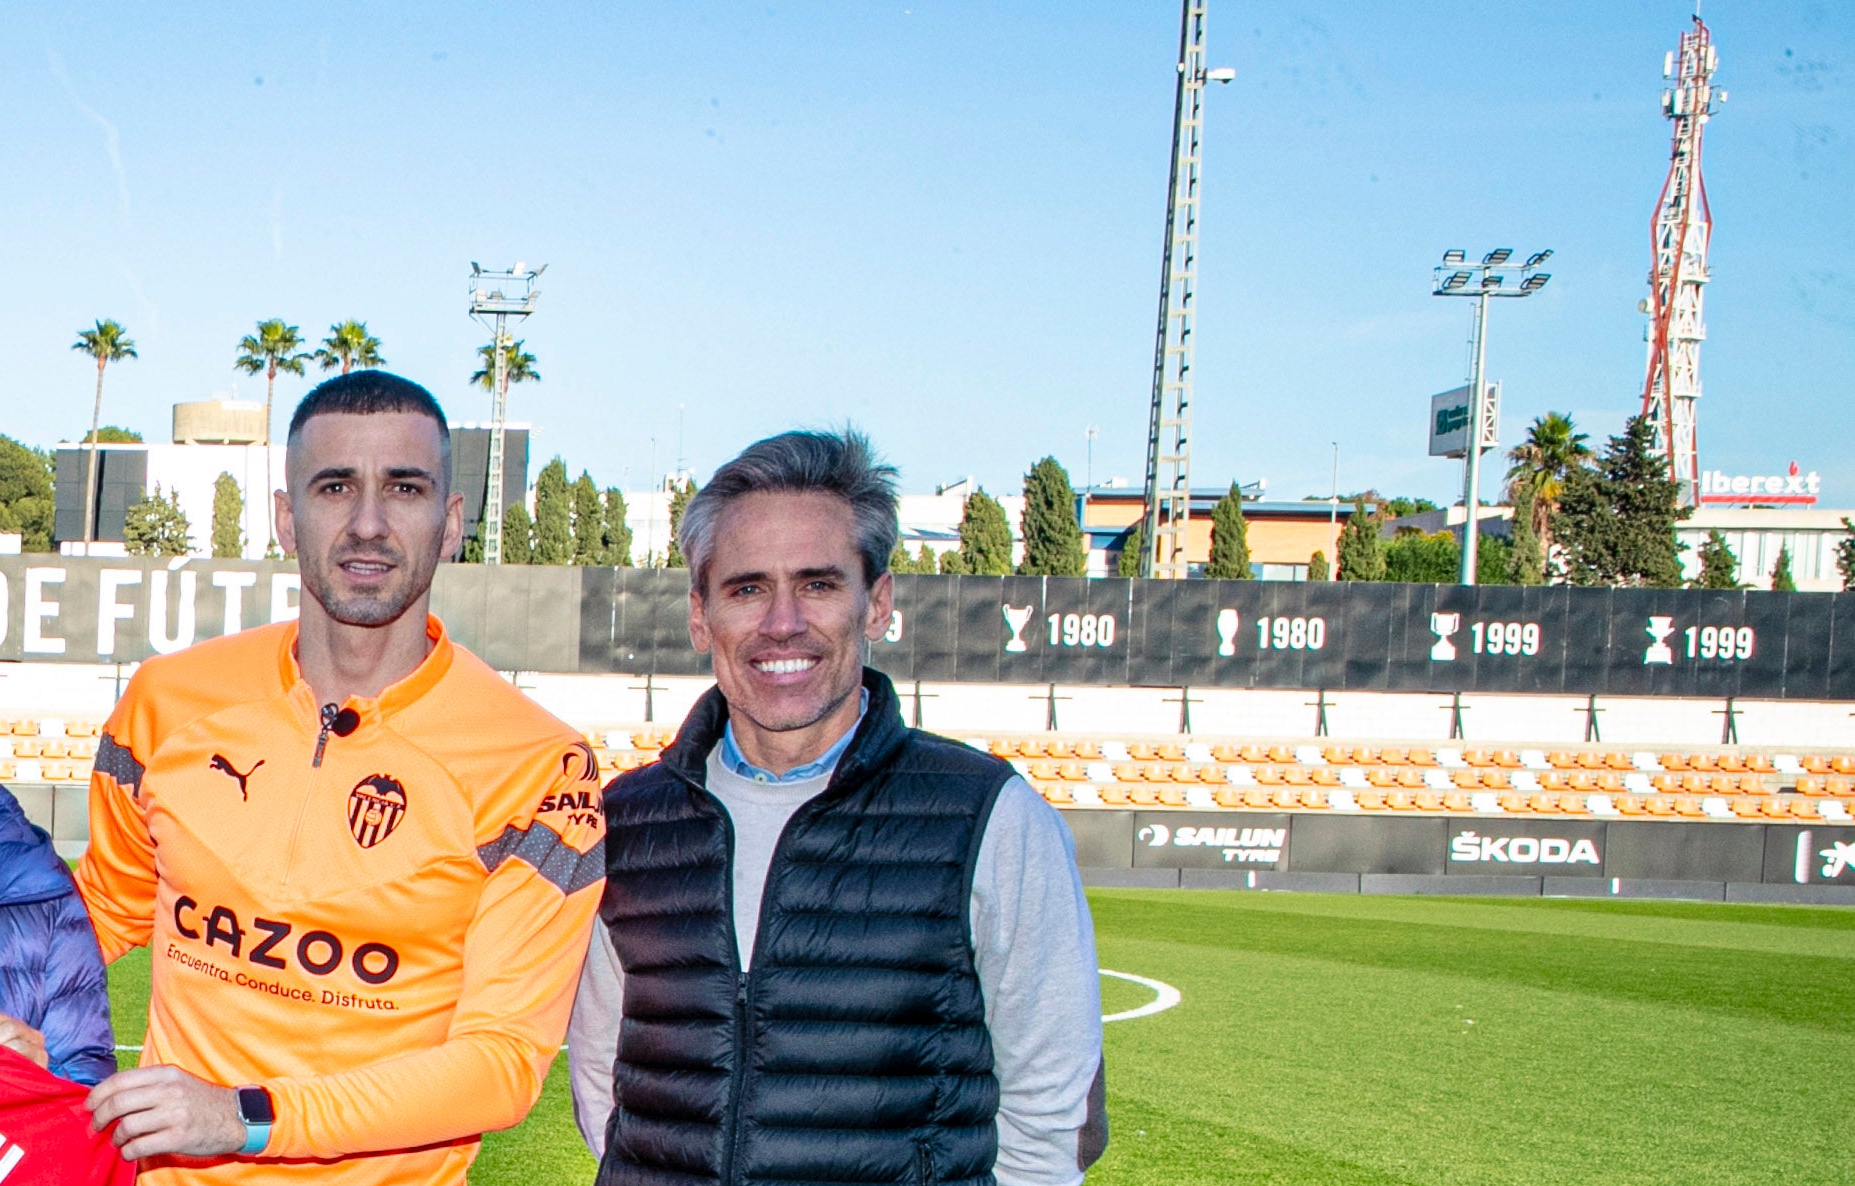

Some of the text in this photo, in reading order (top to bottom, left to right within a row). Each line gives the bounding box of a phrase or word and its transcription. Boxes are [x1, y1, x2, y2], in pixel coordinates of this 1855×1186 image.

[1701, 470, 1820, 493] Iberext
[1048, 613, 1115, 647] 1980
[1257, 617, 1326, 650] 1980
[1471, 622, 1540, 656] 1999
[1685, 627, 1754, 660] 1999
[1173, 827, 1286, 848] SAILUN
[1451, 831, 1600, 865] ŠKODA
[1222, 848, 1280, 863] TYRE
[174, 895, 399, 985] CAZOO
[167, 944, 399, 1011] Encuentra. Conduce. Disfruta.
